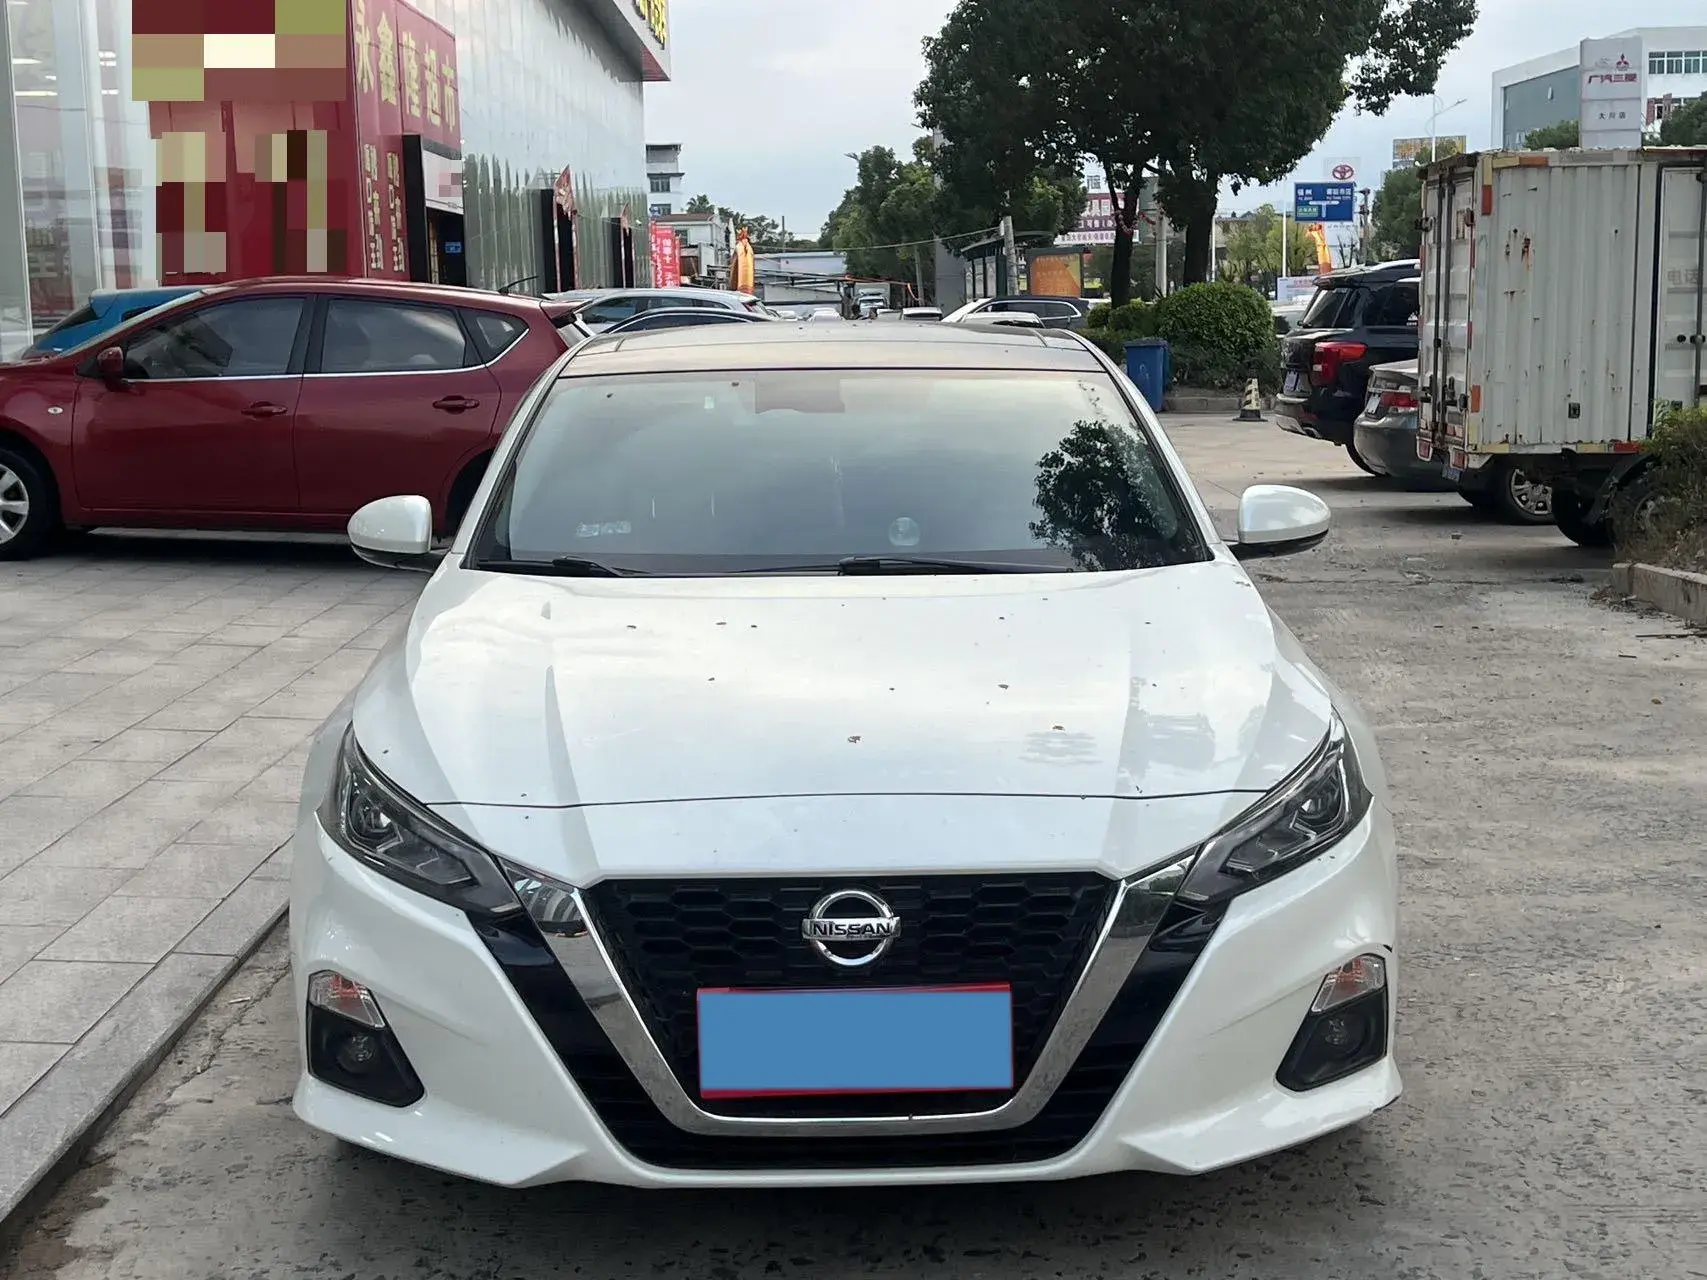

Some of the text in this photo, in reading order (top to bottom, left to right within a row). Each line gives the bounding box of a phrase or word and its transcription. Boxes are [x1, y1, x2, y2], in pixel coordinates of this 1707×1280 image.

[355, 0, 456, 132] 永鑫隆超市
[1588, 73, 1638, 84] 广汽三菱
[812, 921, 891, 937] NISSAN
